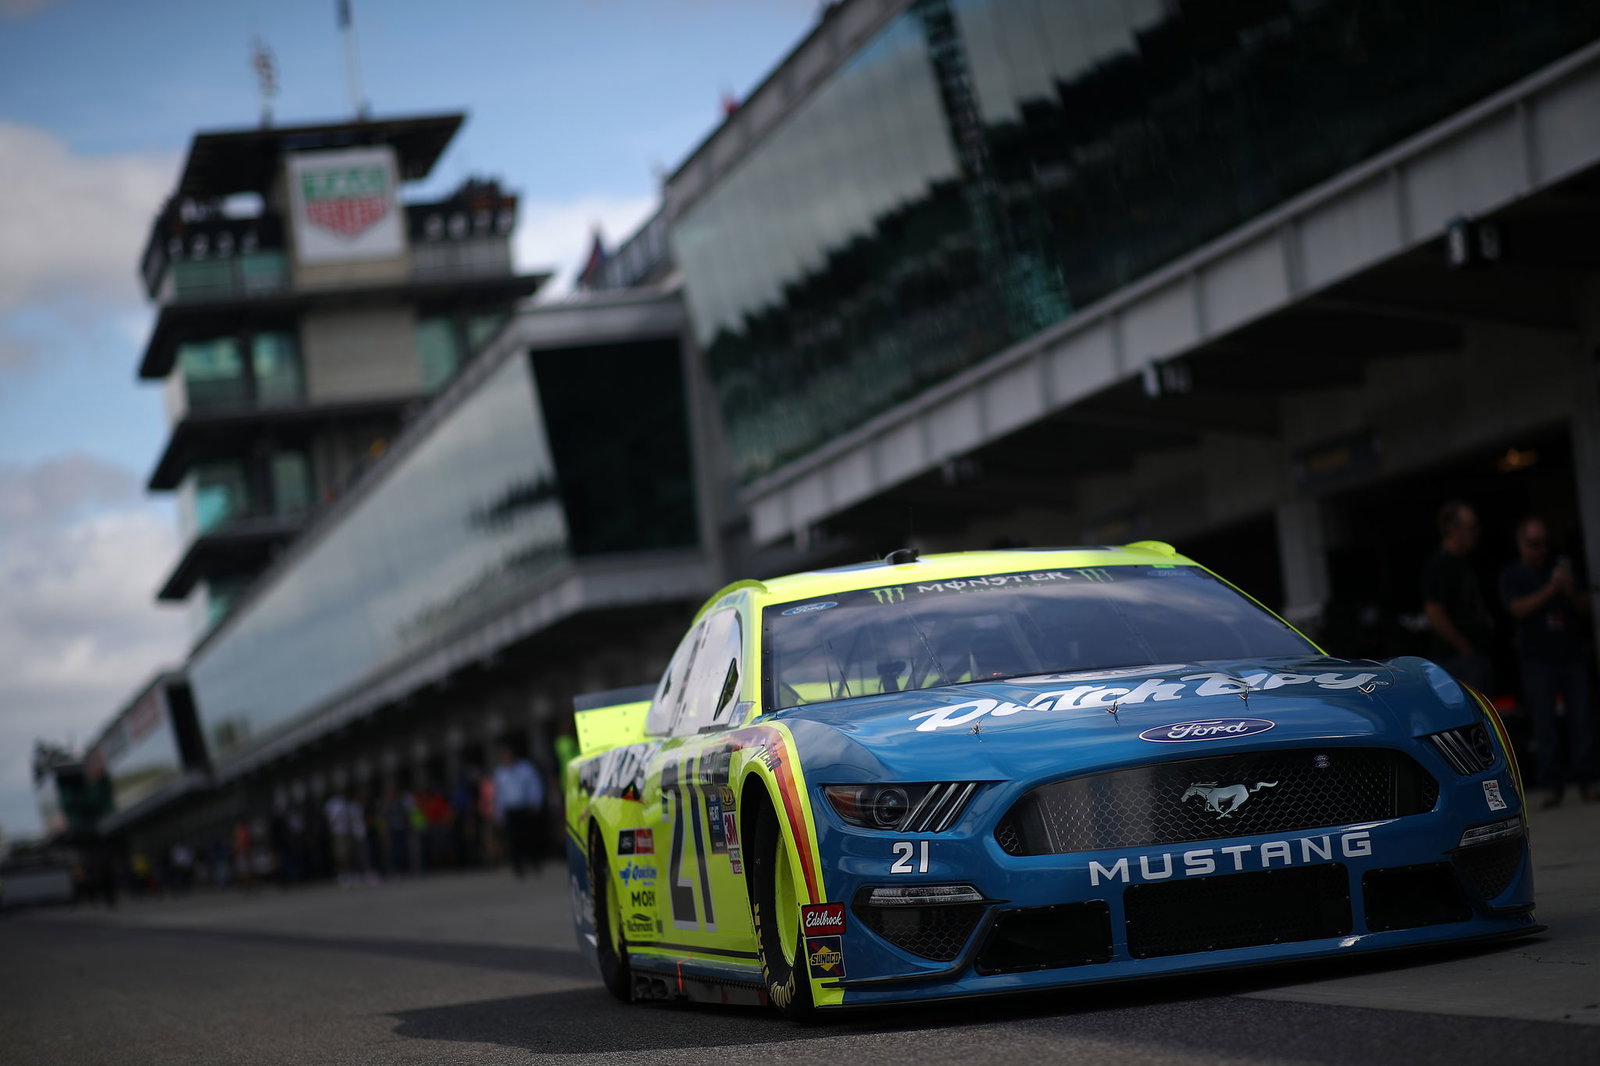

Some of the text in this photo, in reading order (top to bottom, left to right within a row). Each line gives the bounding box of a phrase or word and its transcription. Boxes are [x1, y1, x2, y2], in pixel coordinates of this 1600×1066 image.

[917, 571, 1071, 593] MONSTER
[792, 603, 827, 615] Ford
[907, 672, 1378, 731] Dutch Boy
[1167, 720, 1248, 739] Ford
[661, 756, 717, 932] 21
[890, 840, 929, 873] 21
[1088, 831, 1372, 886] MUSTANG
[806, 910, 842, 928] Edelbrock
[811, 952, 840, 965] SUNOCO
